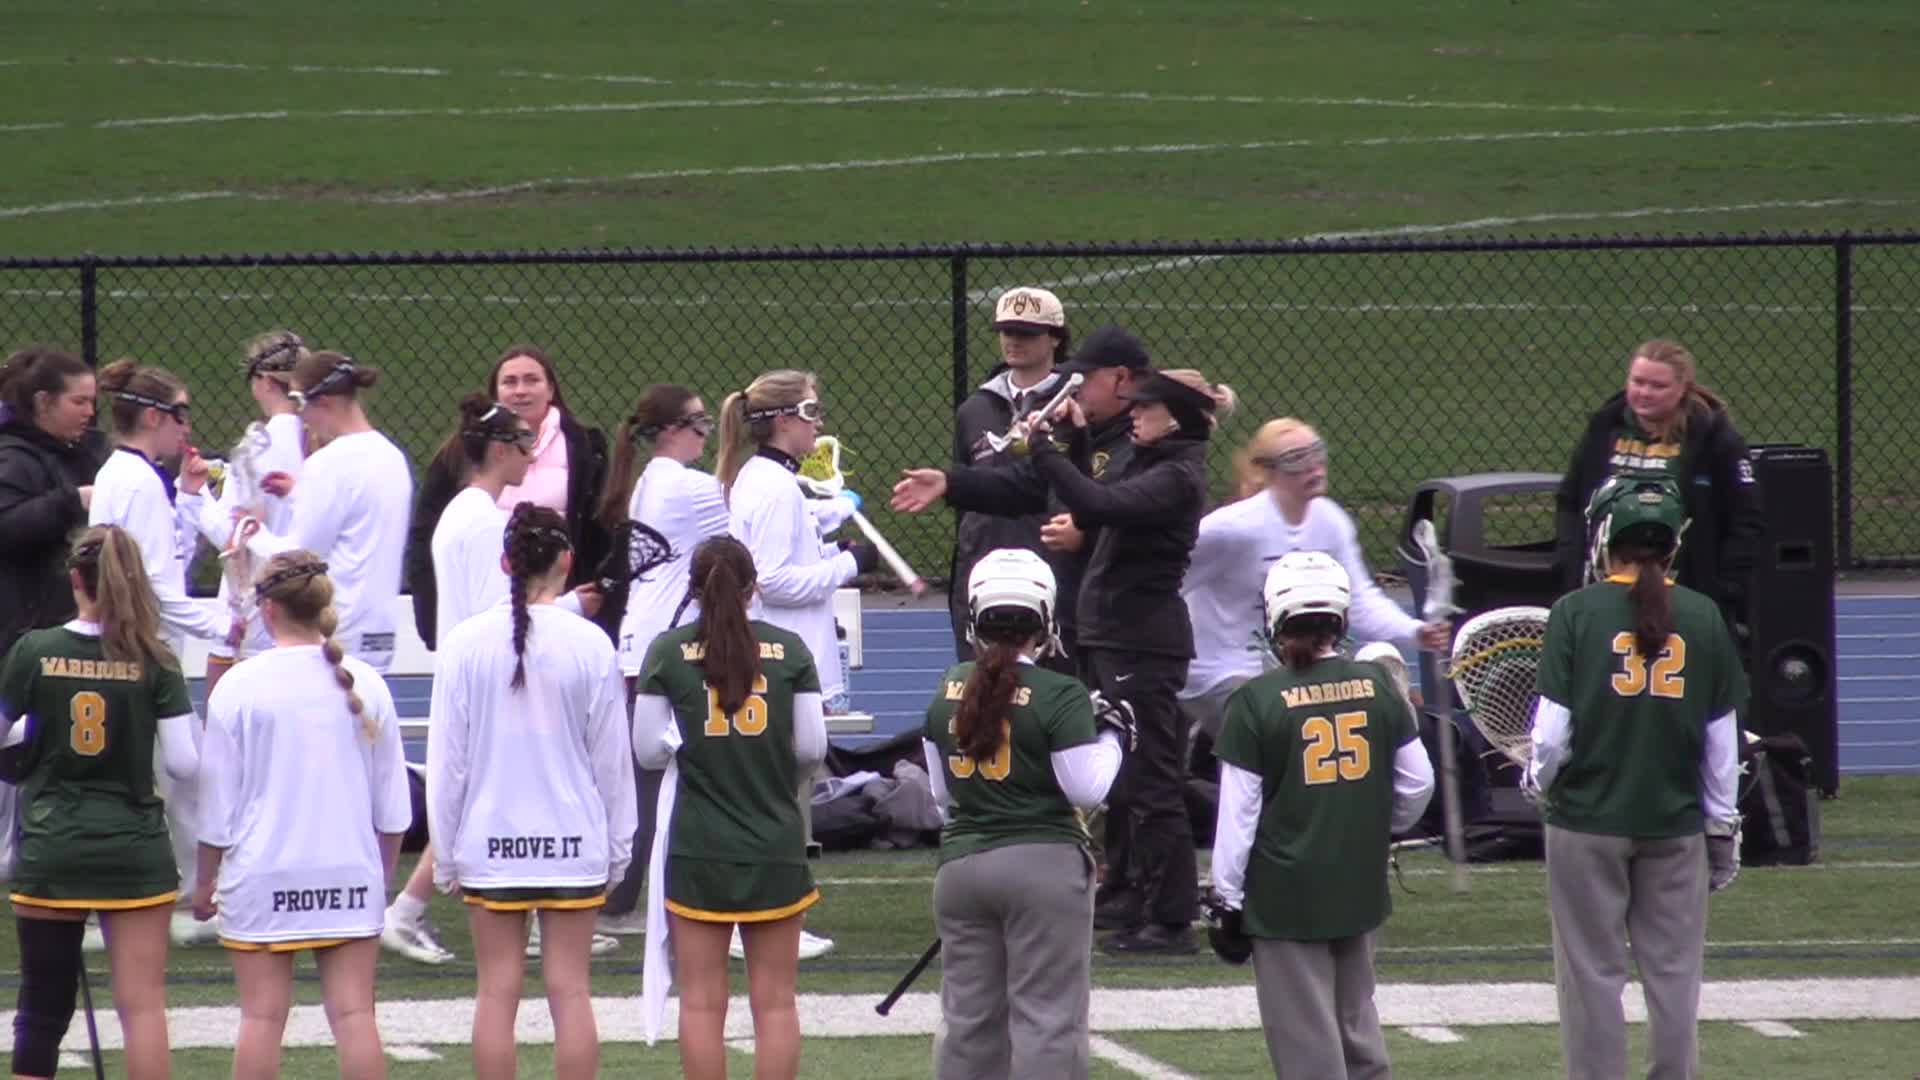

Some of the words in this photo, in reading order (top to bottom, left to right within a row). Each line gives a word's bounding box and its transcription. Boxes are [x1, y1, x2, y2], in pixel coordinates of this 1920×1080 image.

[40, 656, 141, 682] WARRIORS
[1612, 631, 1686, 698] 32
[703, 671, 768, 736] 16
[1281, 679, 1375, 708] WARRIORS
[70, 690, 105, 756] 8
[1301, 711, 1370, 785] 25
[487, 836, 556, 859] PROVE
[561, 835, 583, 858] IT
[272, 887, 342, 912] PROVE
[347, 884, 368, 909] IT
